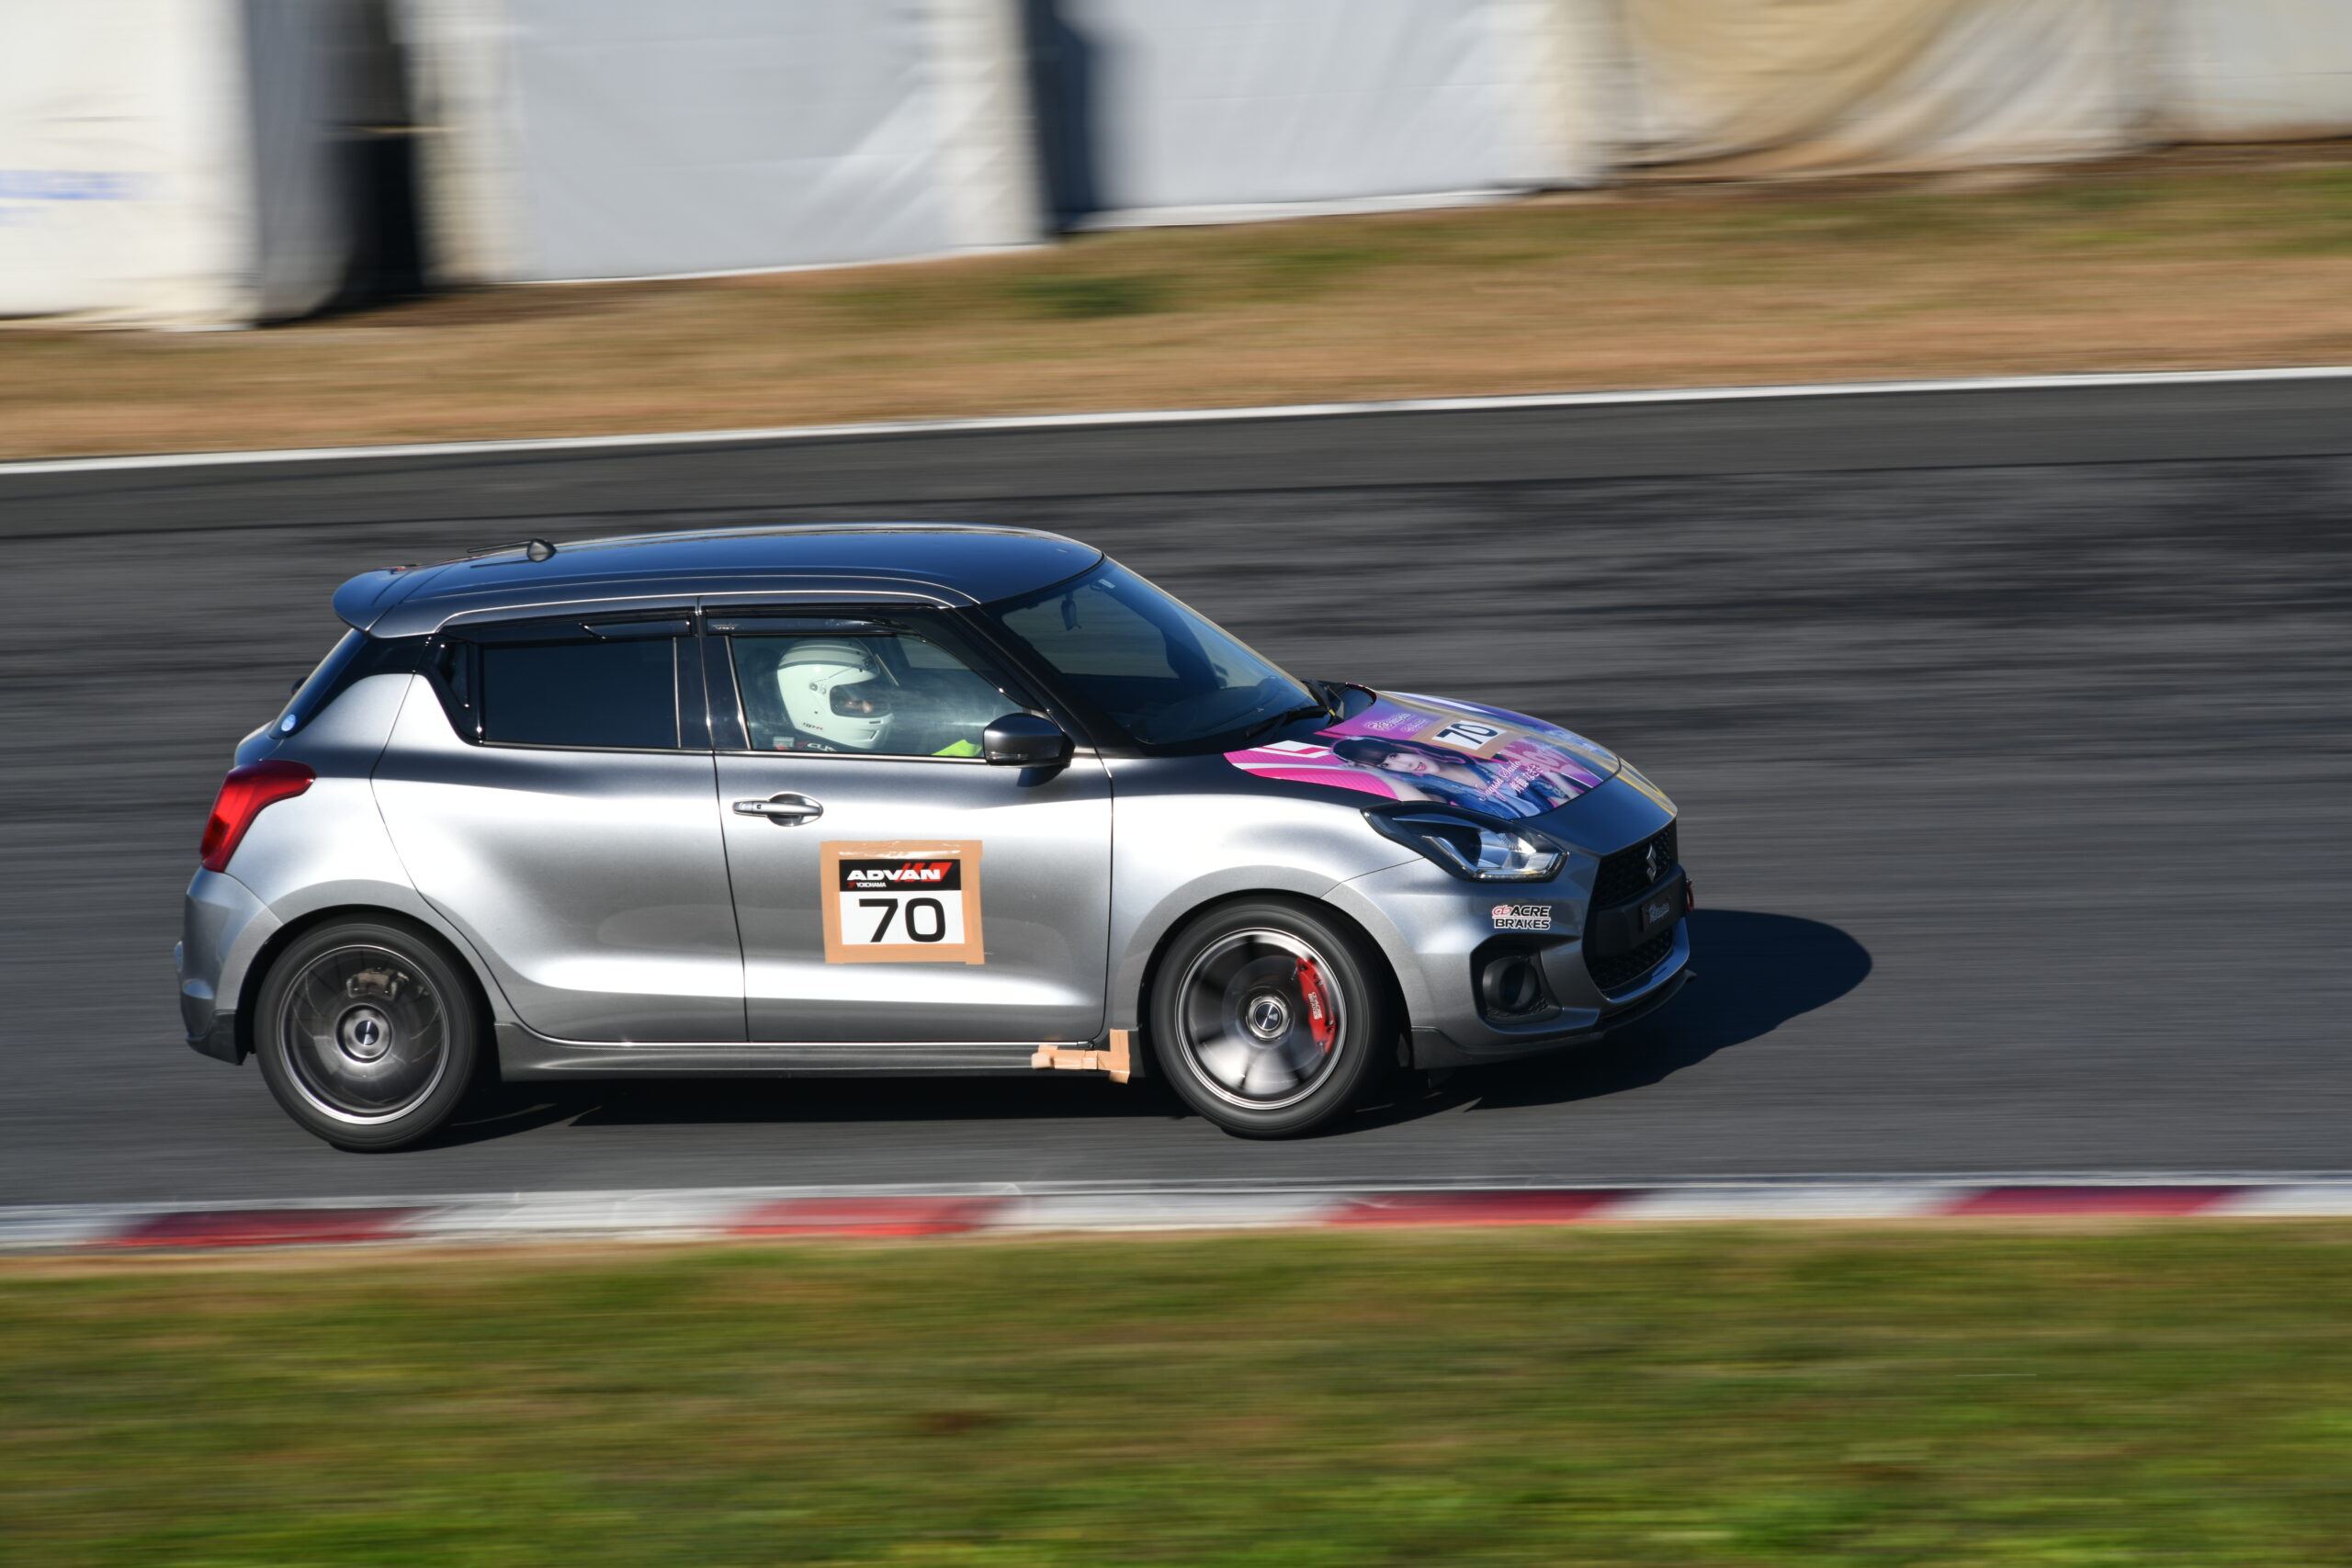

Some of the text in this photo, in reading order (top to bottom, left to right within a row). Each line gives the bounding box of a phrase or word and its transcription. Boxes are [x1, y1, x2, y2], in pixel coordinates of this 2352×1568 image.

[1436, 723, 1498, 745] 70
[846, 869, 941, 881] ADVAN
[1510, 906, 1550, 917] ACRE
[859, 897, 945, 942] 70
[1495, 919, 1550, 929] BRAKES
